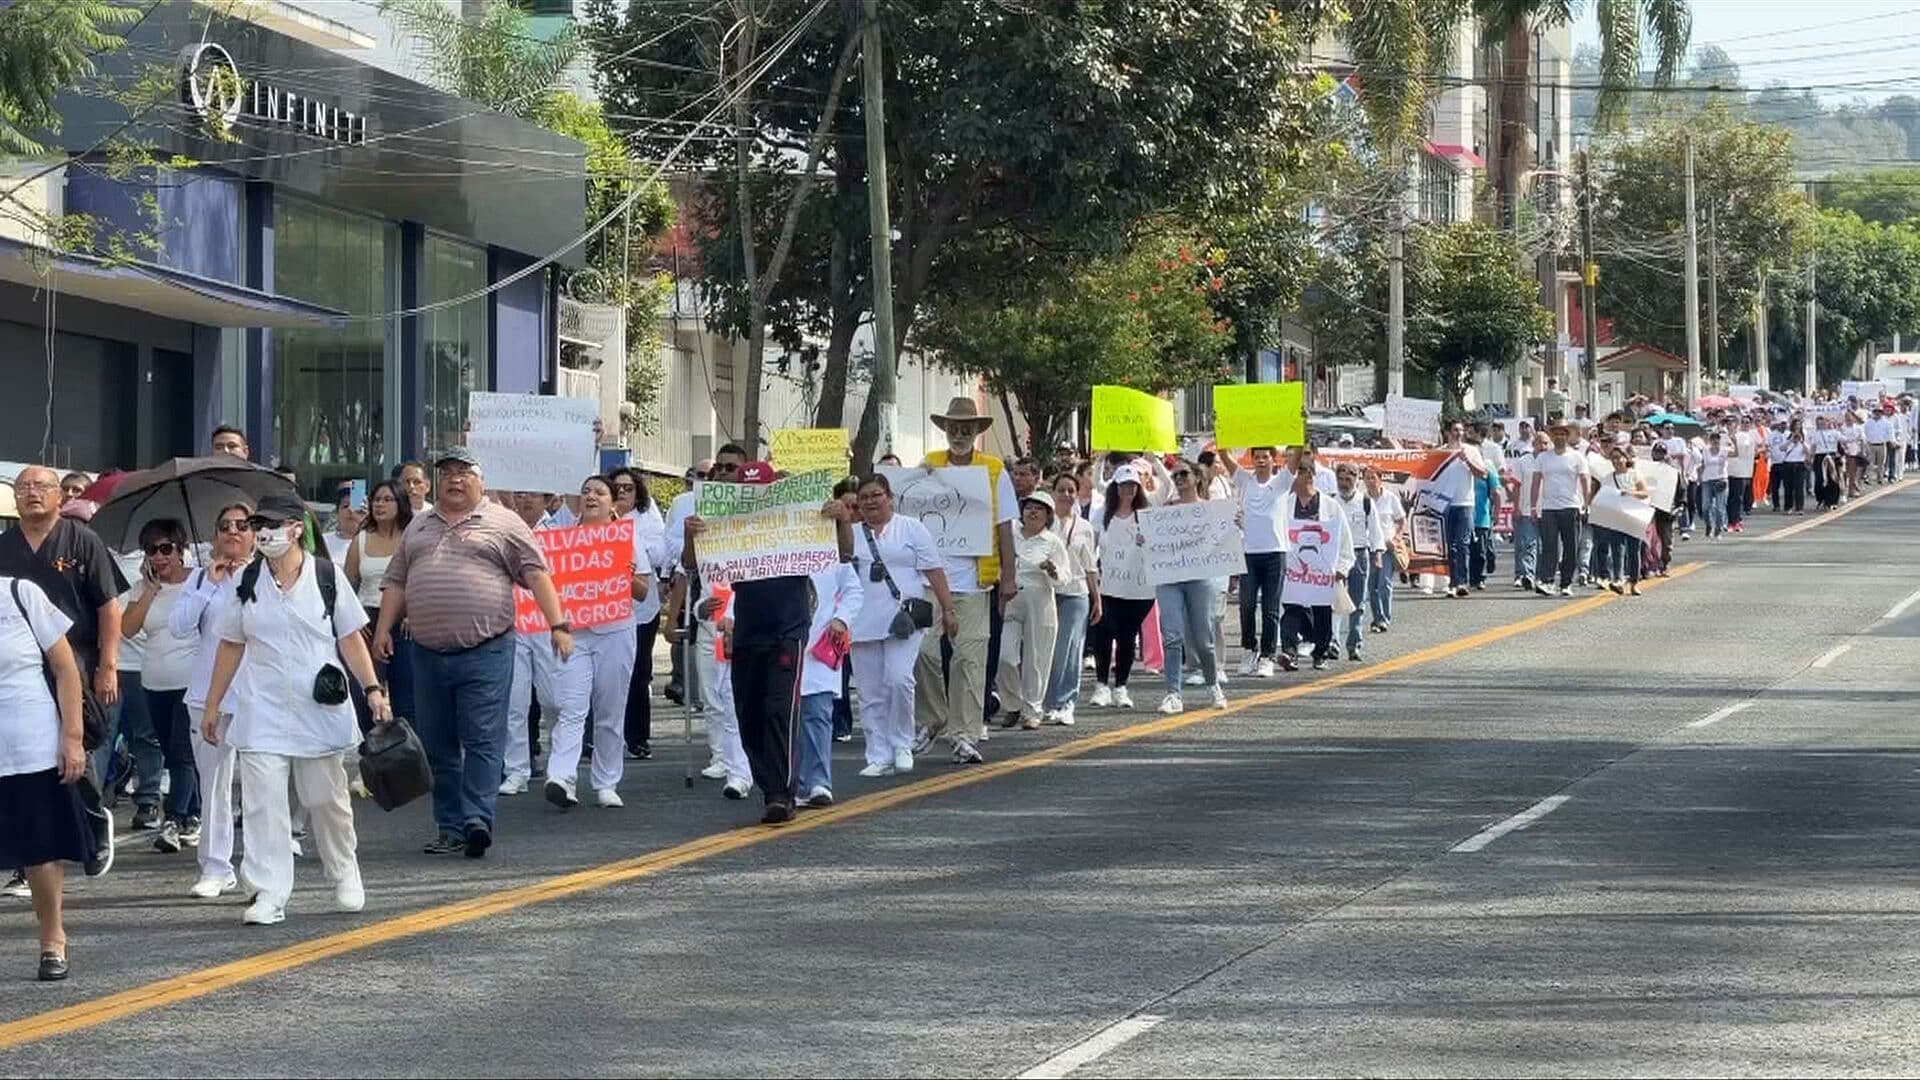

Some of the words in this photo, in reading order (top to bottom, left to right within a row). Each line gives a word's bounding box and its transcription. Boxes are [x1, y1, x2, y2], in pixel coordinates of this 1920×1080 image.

[254, 80, 367, 147] INFINITI
[702, 483, 737, 500] POR
[740, 485, 756, 499] EL
[815, 467, 832, 485] DE
[775, 552, 789, 563] UN
[707, 573, 724, 583] NO
[728, 570, 746, 581] UN
